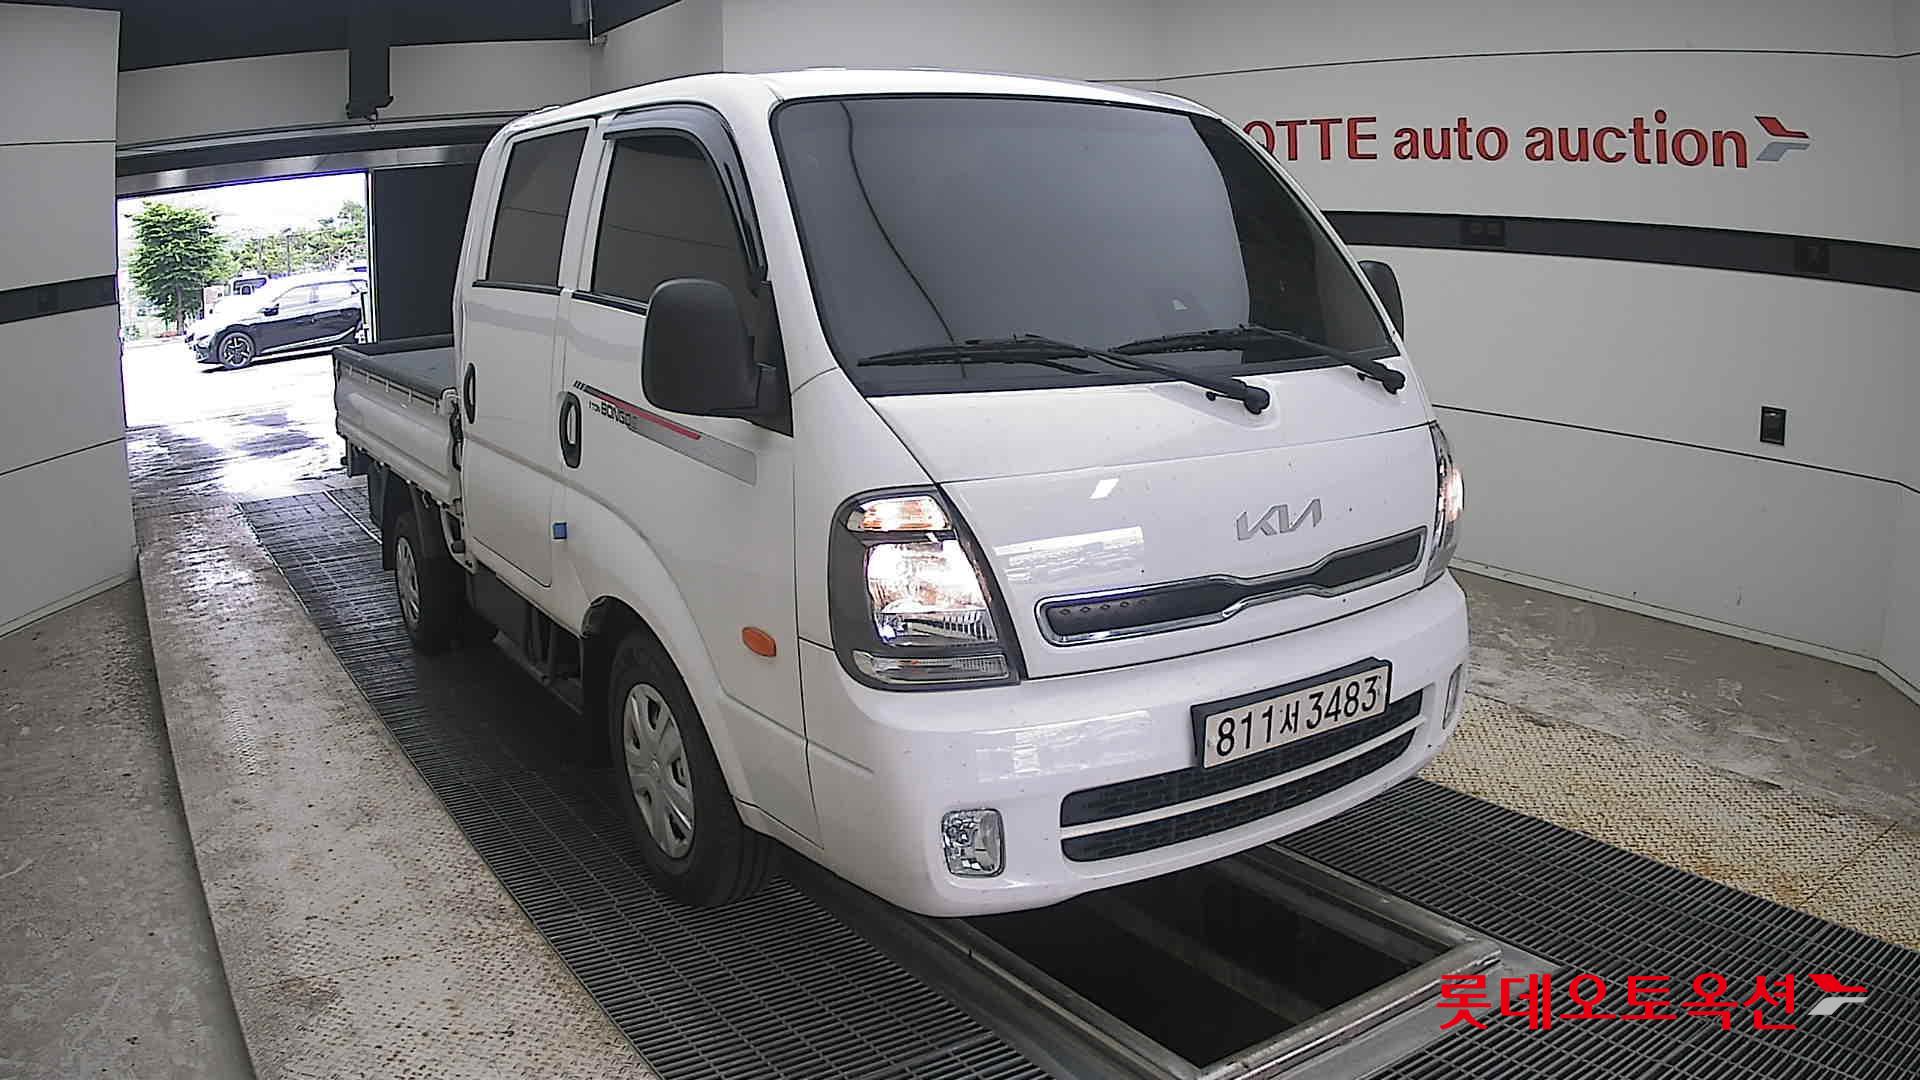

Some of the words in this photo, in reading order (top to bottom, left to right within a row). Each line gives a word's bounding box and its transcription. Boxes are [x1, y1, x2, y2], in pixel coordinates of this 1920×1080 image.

[1243, 117, 1378, 161] OTTE
[1393, 117, 1509, 161] auto
[1525, 109, 1748, 169] auction
[1236, 499, 1322, 541] KIA
